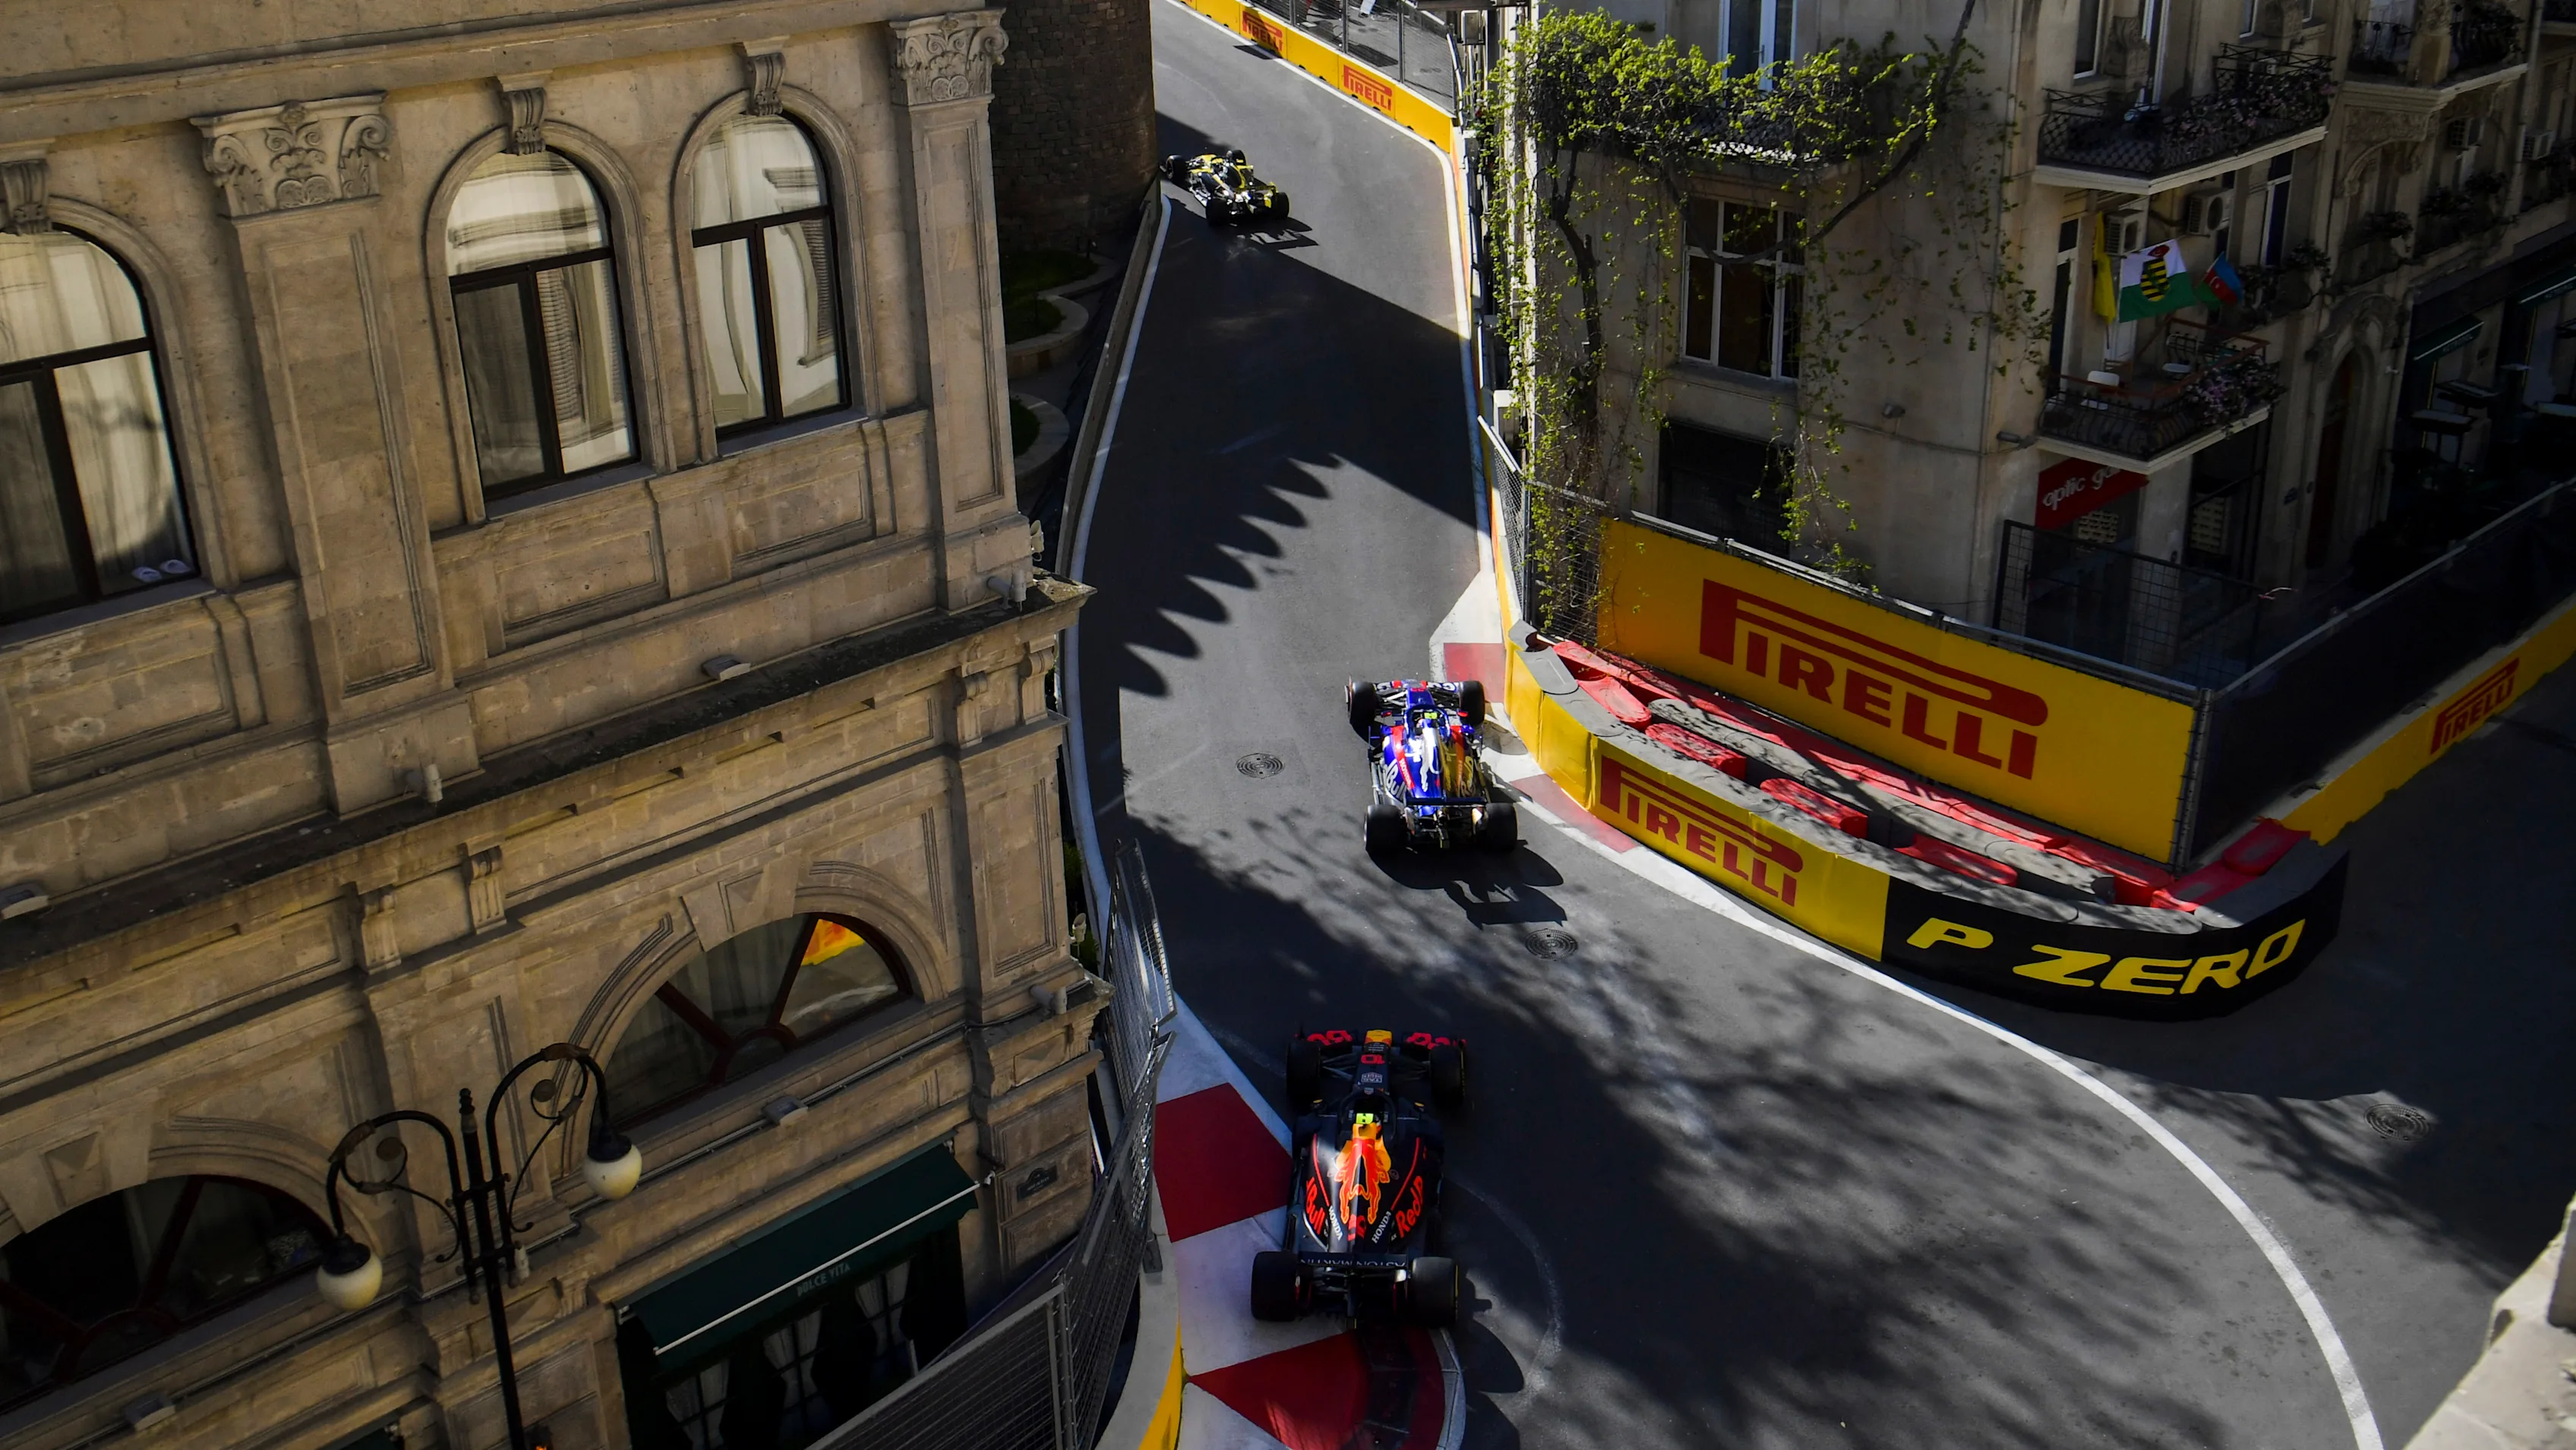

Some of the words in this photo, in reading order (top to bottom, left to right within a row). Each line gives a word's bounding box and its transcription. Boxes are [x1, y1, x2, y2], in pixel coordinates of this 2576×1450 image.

[1242, 10, 1283, 52] PIRELLI
[1343, 65, 1392, 112] PIRELLI
[2042, 476, 2087, 511] optic
[1700, 578, 2048, 780] PIRELLI
[2430, 658, 2520, 755] PIRELLI
[1600, 755, 1804, 908] PIRELLI
[1906, 917, 1995, 949] P
[2012, 918, 2306, 996] ZERO
[1328, 1205, 1343, 1241] HONDA
[1371, 1210, 1392, 1244] HONDA
[796, 1272, 828, 1297] DOLCE
[829, 1262, 851, 1280] VITA
